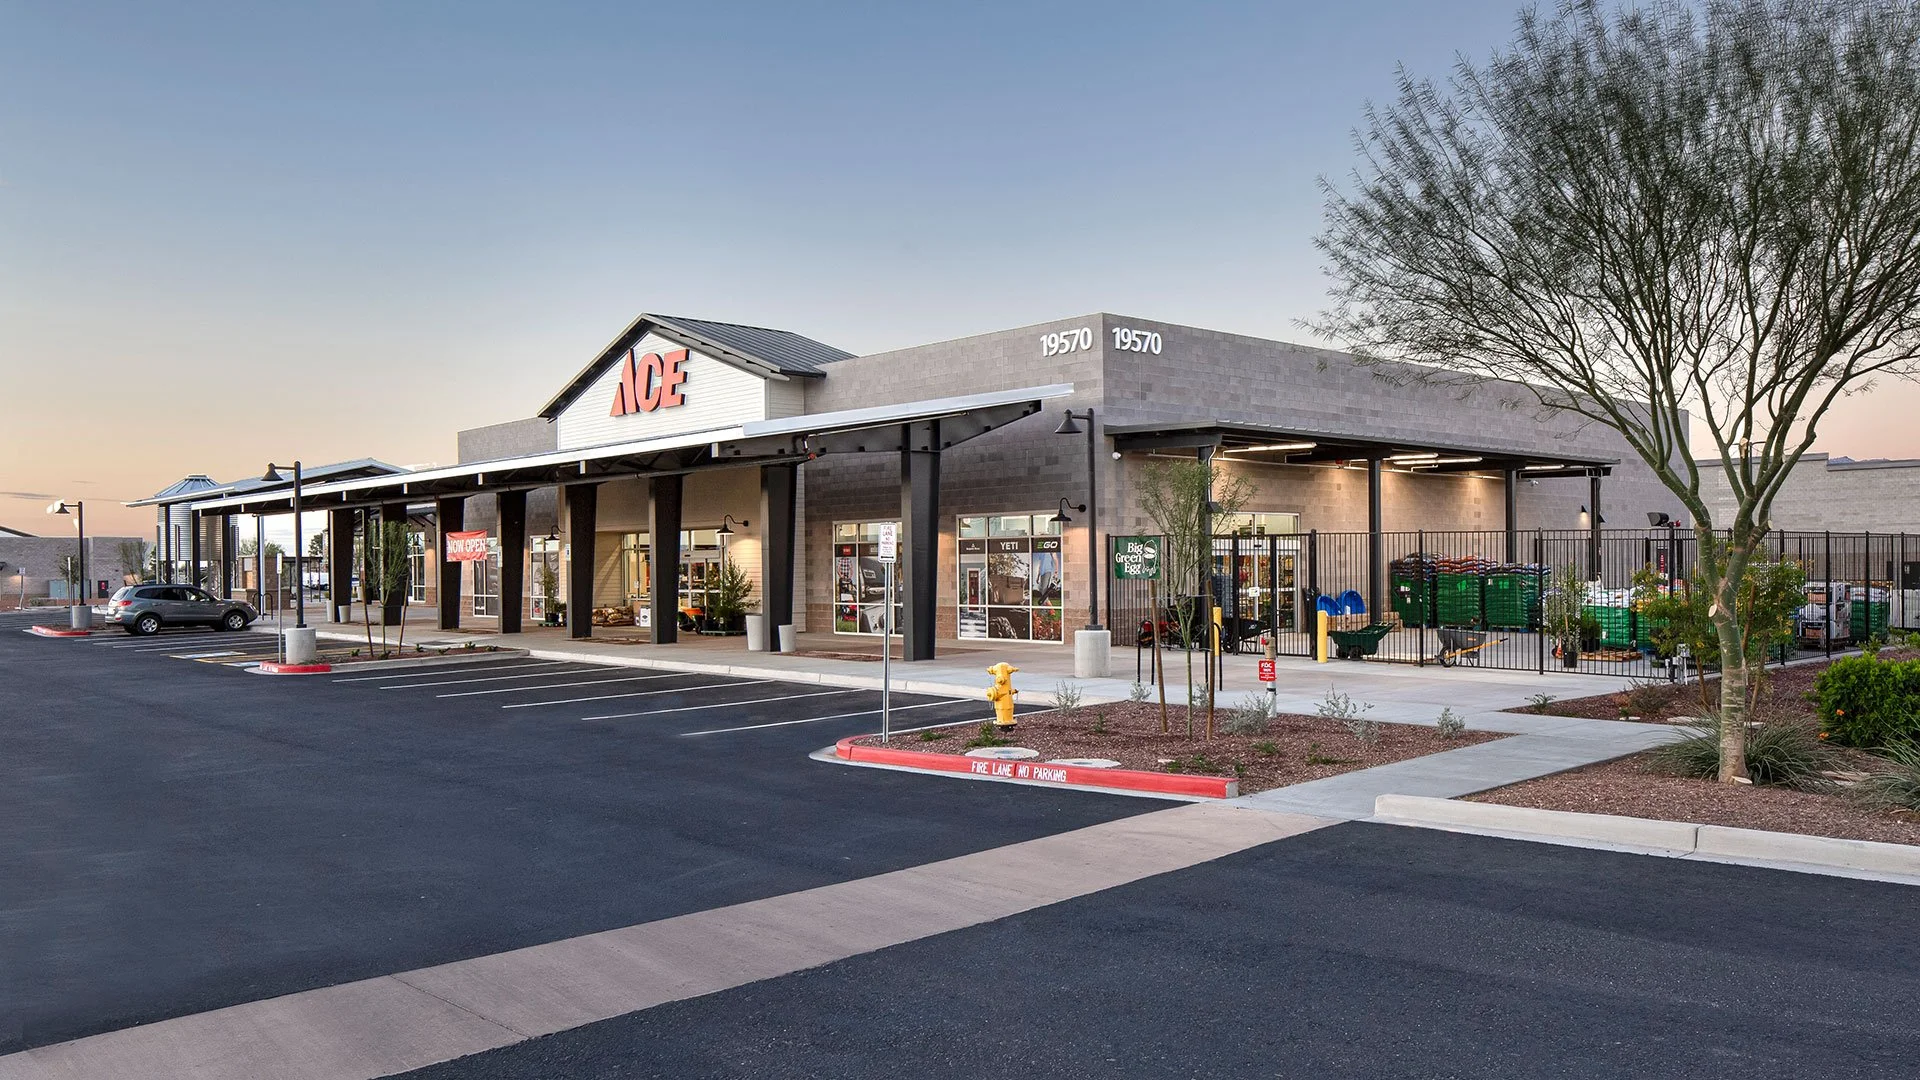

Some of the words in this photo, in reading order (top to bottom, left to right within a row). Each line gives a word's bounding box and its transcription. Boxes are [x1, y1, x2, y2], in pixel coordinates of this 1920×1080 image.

[1040, 327, 1093, 357] 19570
[1112, 327, 1163, 355] 19570
[610, 348, 690, 416] ACE
[447, 539, 464, 553] NOW
[465, 538, 486, 552] OPEN
[1000, 541, 1018, 551] YETI
[1127, 542, 1143, 554] Big
[1115, 552, 1141, 563] Green
[1124, 562, 1141, 575] Egg
[971, 761, 988, 774] FIRE
[992, 763, 1013, 776] LANE
[1018, 765, 1029, 778] NO
[1033, 767, 1067, 782] PARKING
